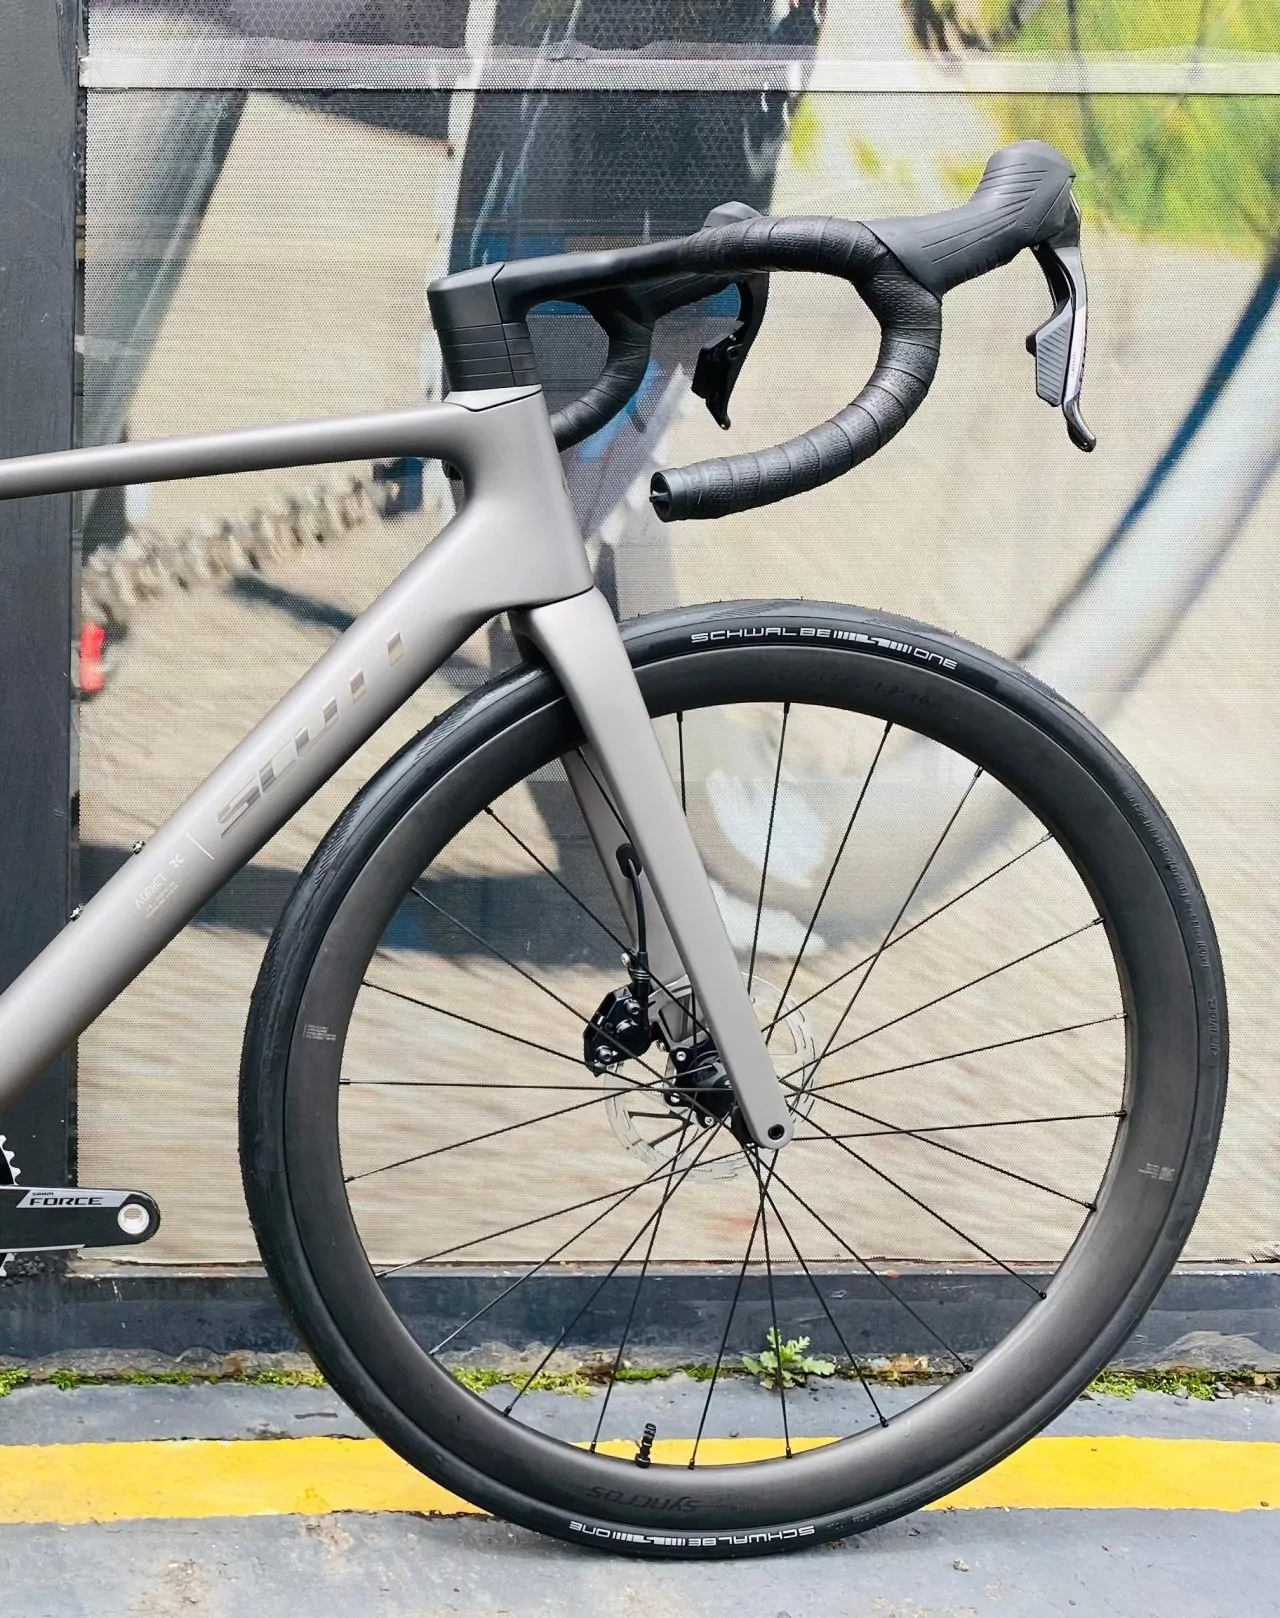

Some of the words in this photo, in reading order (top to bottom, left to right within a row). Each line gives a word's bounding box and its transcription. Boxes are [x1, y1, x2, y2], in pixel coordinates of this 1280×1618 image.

[690, 626, 832, 644] SCHWALBE
[913, 648, 958, 670] ONE
[29, 1197, 103, 1206] FORCE
[569, 1521, 611, 1537] ONE
[688, 1525, 816, 1547] SCHWALBE
